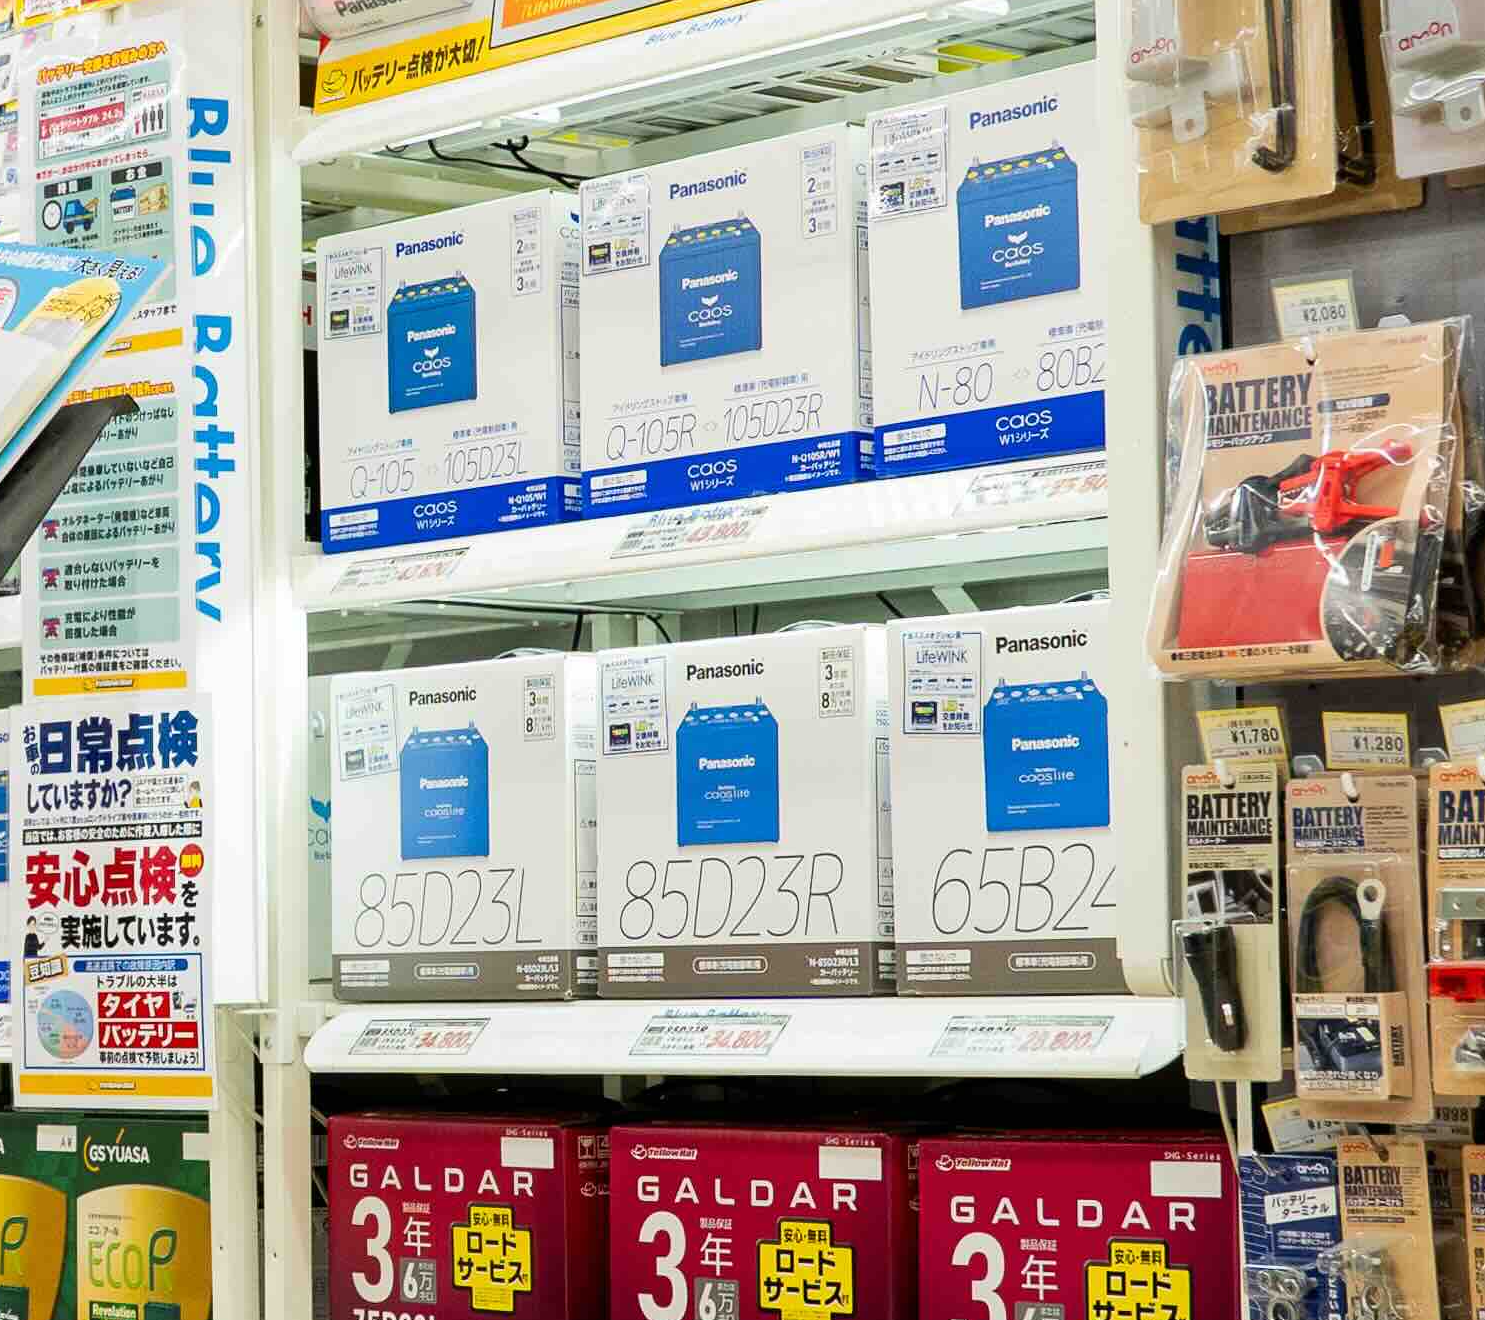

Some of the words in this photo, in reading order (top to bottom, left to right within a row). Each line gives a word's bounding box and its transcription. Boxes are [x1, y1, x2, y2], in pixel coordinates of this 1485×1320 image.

[350, 35, 485, 93] バッテリー点検が大切!
[968, 93, 1061, 130] Panasonic
[668, 168, 749, 200] Panasonic
[394, 230, 465, 259] Panasonic
[1302, 304, 1348, 323] ¥2,080
[916, 362, 996, 407] N-80
[604, 416, 699, 464] Q-105R
[723, 393, 825, 445] 105D23R
[685, 656, 766, 682] Panasonic
[39, 709, 200, 776] 日常点検
[1229, 725, 1281, 745] ¥1,780
[1351, 734, 1405, 754] ¥1,280
[27, 778, 132, 814] していますか?
[1186, 792, 1271, 820] BATTERY
[1186, 815, 1272, 839] MAINTENANCE
[25, 845, 178, 909] 安心点検
[353, 863, 547, 952] 85D23L
[623, 851, 847, 944] 85D23R
[59, 911, 202, 949] 実施しています。
[100, 994, 166, 1017] タイヤ
[100, 1024, 196, 1048] バッテリー
[348, 1161, 537, 1198] GALDAR
[636, 1174, 859, 1212] GALDAR
[950, 1193, 1197, 1233] GALDAR
[1103, 1266, 1172, 1299] ロード
